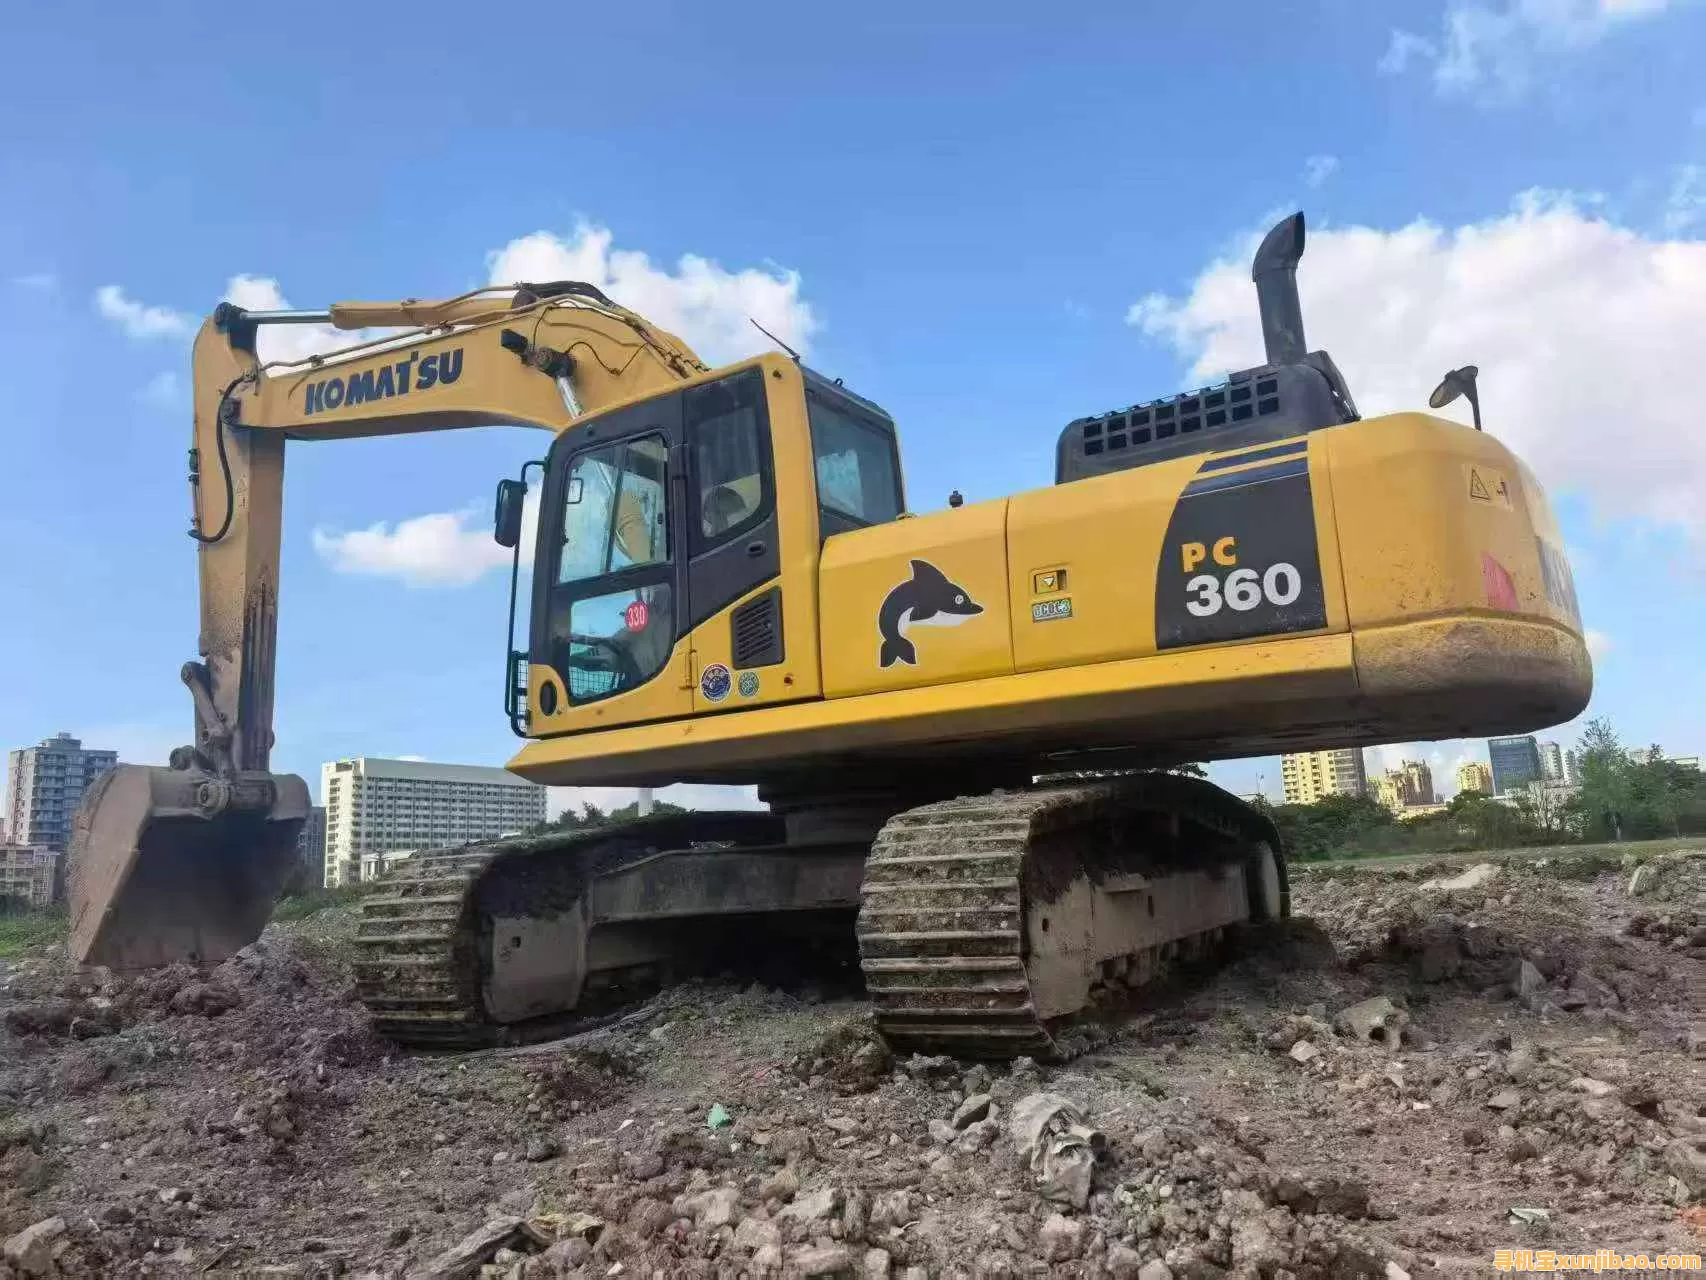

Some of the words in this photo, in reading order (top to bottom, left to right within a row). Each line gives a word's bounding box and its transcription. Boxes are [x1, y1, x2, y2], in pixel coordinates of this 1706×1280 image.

[304, 347, 464, 416] KOMATSU
[1182, 536, 1237, 573] PC
[1186, 562, 1302, 617] 360
[628, 604, 646, 627] 330
